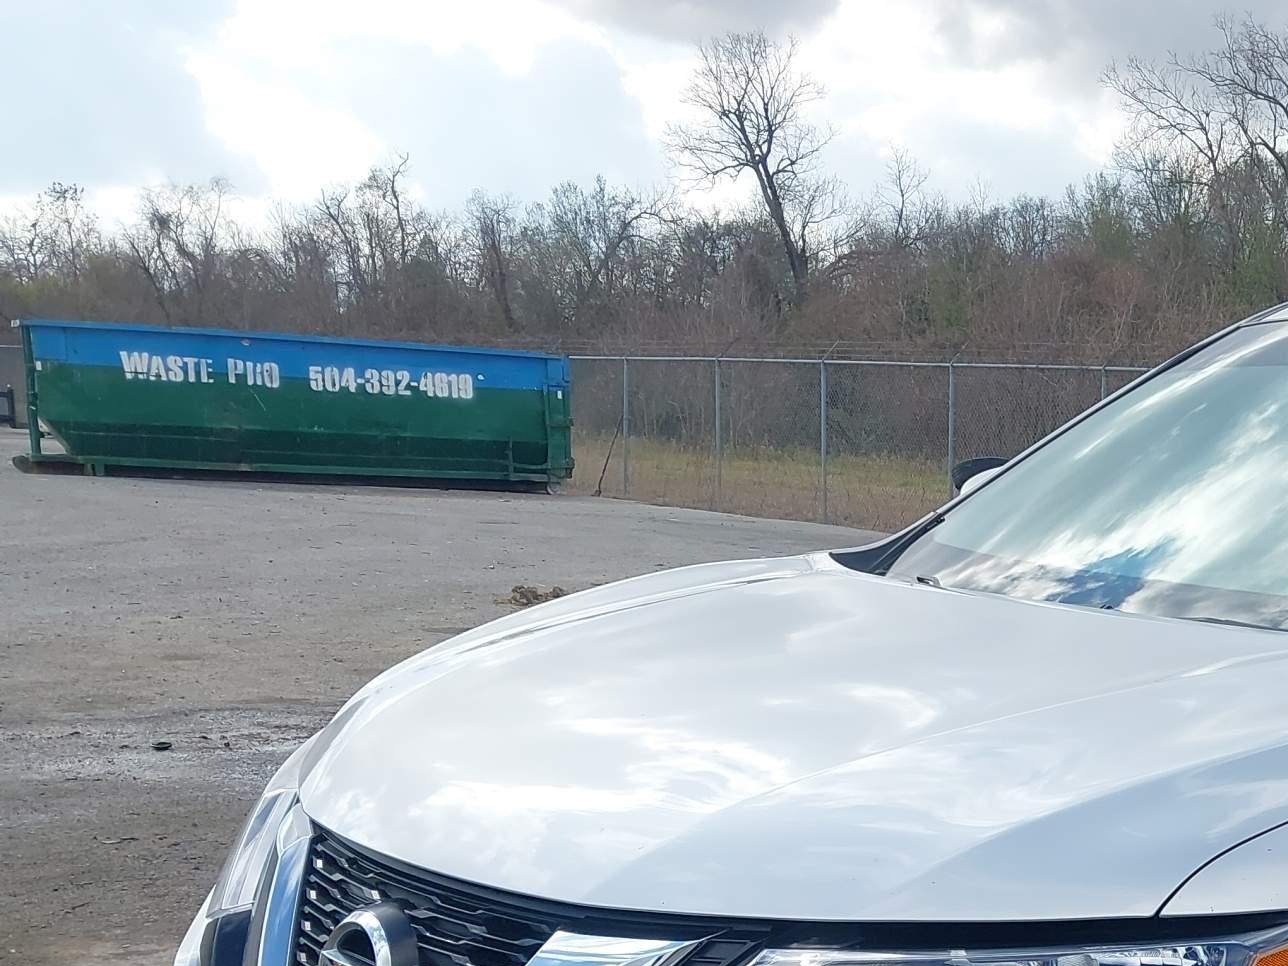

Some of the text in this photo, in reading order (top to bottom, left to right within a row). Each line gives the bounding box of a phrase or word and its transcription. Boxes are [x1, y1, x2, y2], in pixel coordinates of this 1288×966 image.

[120, 351, 473, 399] WASTE PRO 504-392-4619
